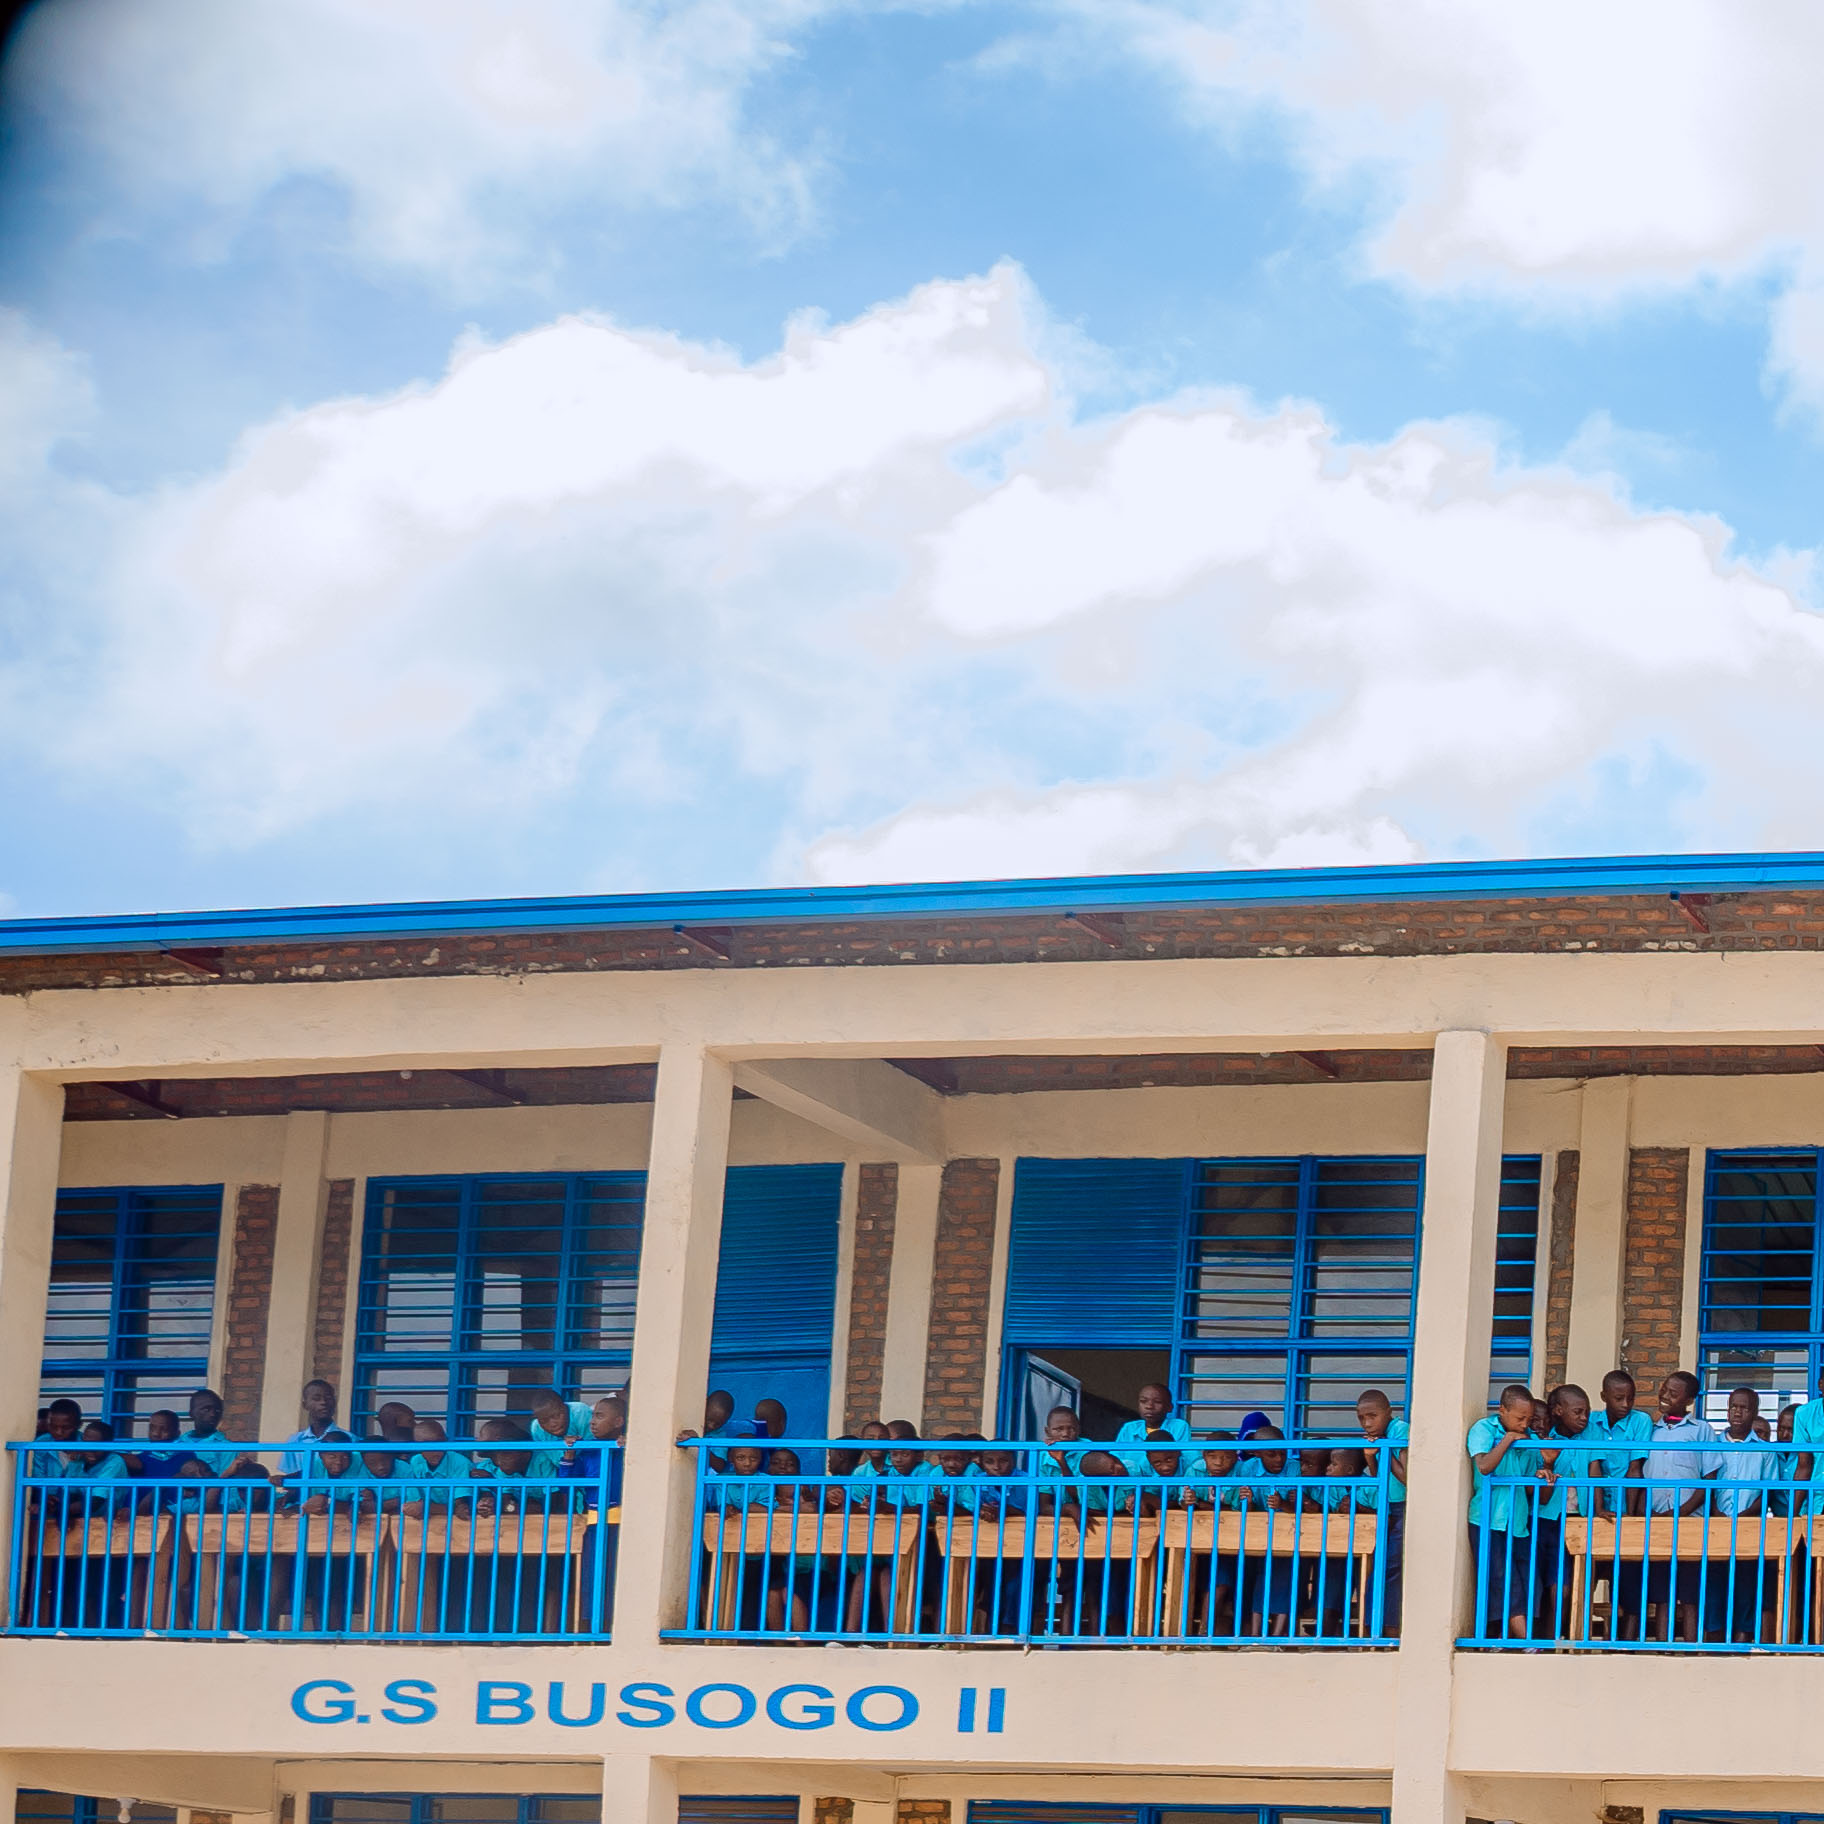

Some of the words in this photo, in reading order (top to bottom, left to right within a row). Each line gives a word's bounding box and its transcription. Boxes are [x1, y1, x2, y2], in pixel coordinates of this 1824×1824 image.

[291, 1679, 438, 1725] G.S
[476, 1681, 920, 1732] BUSOGO
[957, 1687, 1007, 1734] II
